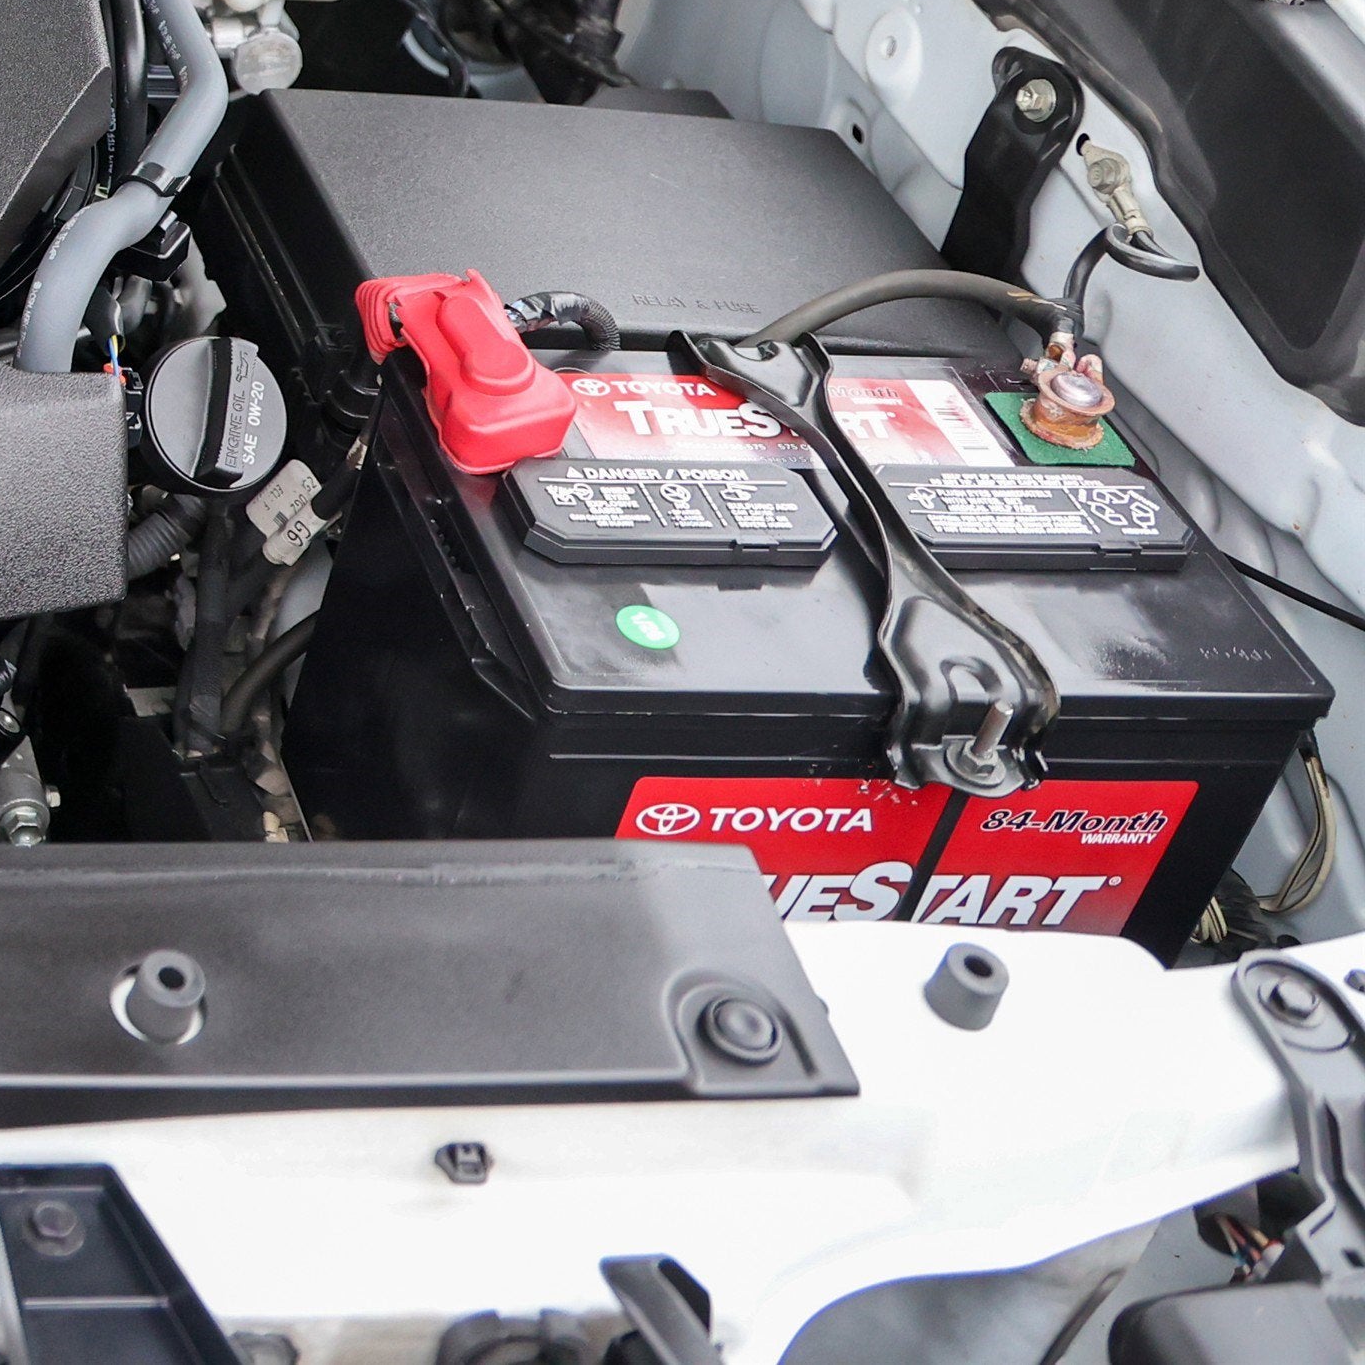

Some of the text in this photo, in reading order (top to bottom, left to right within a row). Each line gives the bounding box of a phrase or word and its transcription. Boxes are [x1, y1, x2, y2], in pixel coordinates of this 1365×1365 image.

[632, 294, 762, 314] RELAY & FUSE
[610, 380, 717, 397] TOYOTA
[225, 390, 247, 469] ENGINE OIL
[242, 380, 266, 466] SAE 0W-20
[580, 466, 750, 482] DANGER / POISON
[286, 520, 312, 547] G6
[709, 807, 874, 833] TOYOTA
[980, 808, 1168, 833] 84-Month
[1080, 832, 1158, 845] WARRANTY
